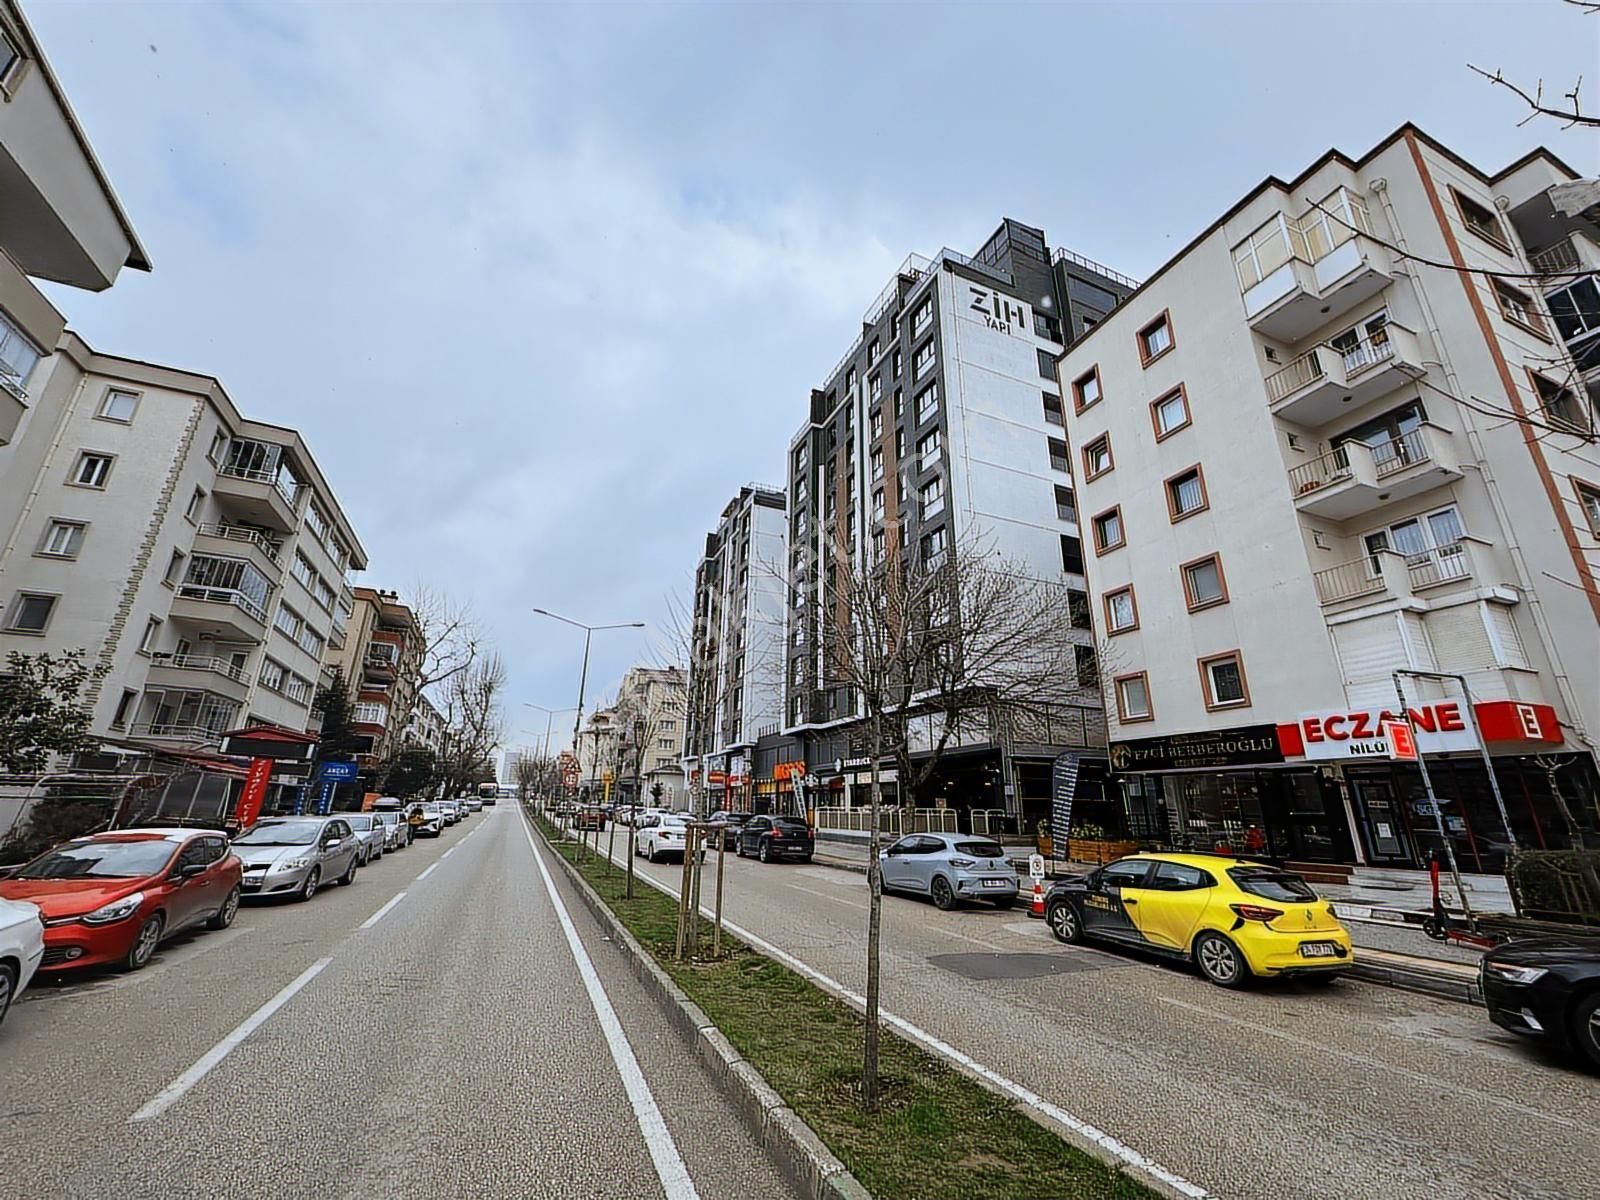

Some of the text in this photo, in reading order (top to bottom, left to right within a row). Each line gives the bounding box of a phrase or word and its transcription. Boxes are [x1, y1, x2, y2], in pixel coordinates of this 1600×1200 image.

[983, 314, 1011, 336] YAPI
[1520, 706, 1540, 734] E
[1168, 736, 1273, 757] BERBEROĞLU
[1350, 740, 1390, 755] NİLÜ
[1392, 727, 1411, 753] E
[842, 757, 873, 768] STARBUCK
